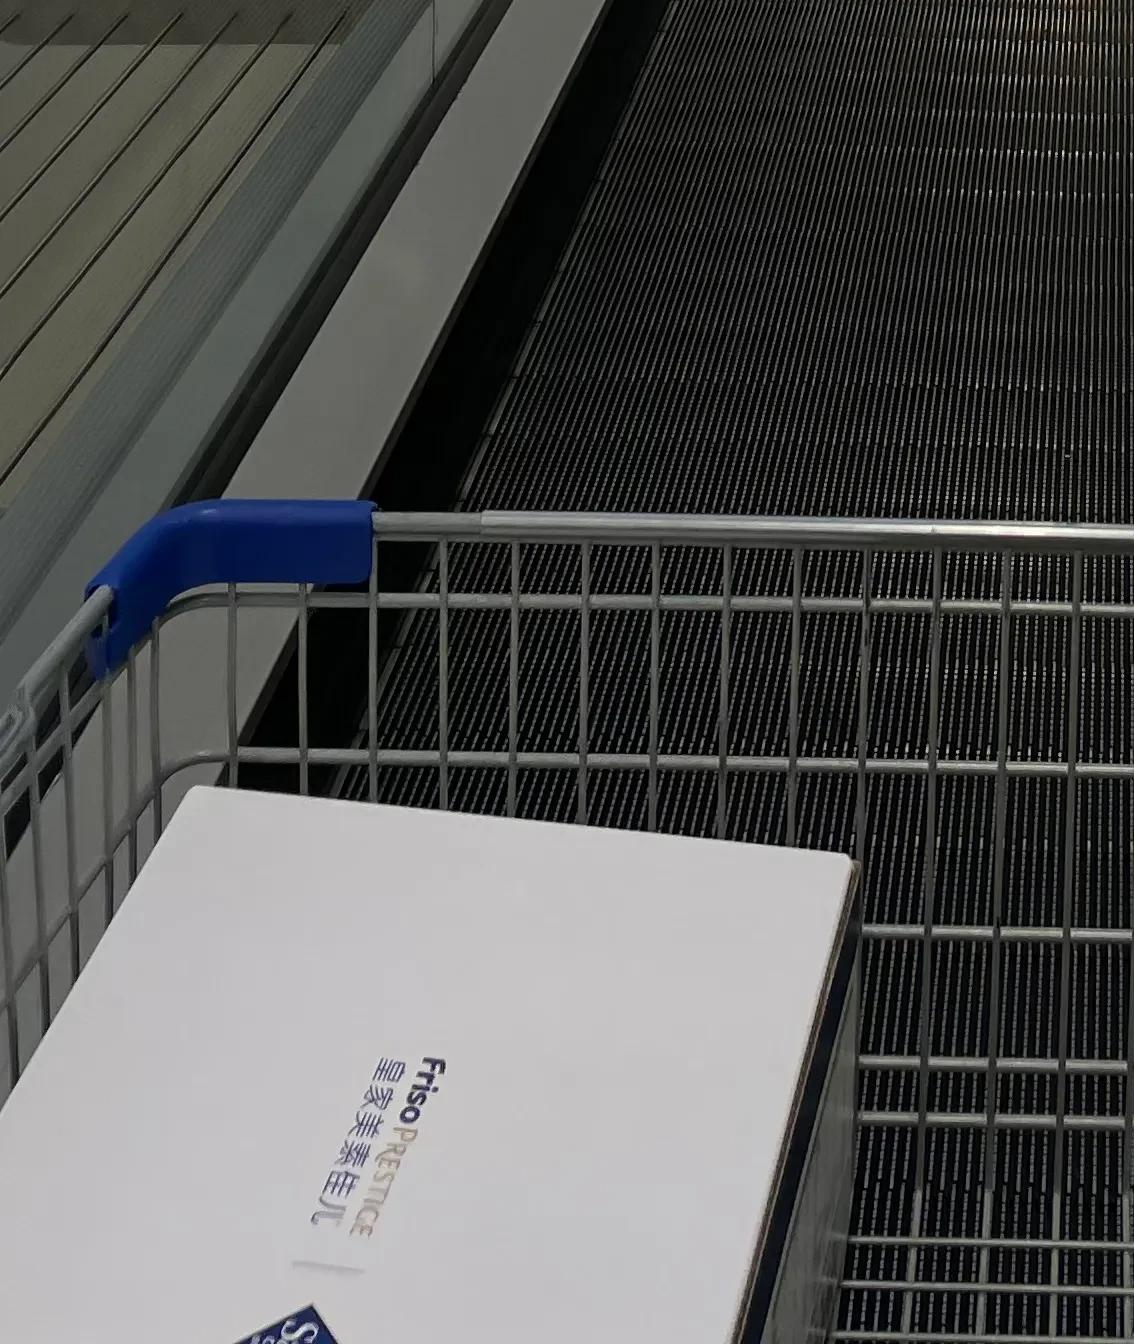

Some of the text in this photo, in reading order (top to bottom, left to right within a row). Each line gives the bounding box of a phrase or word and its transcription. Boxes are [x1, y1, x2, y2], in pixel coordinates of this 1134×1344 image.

[310, 1056, 406, 1226] 皇家美素佳儿
[349, 1056, 446, 1239] Friso PRESTIGE
